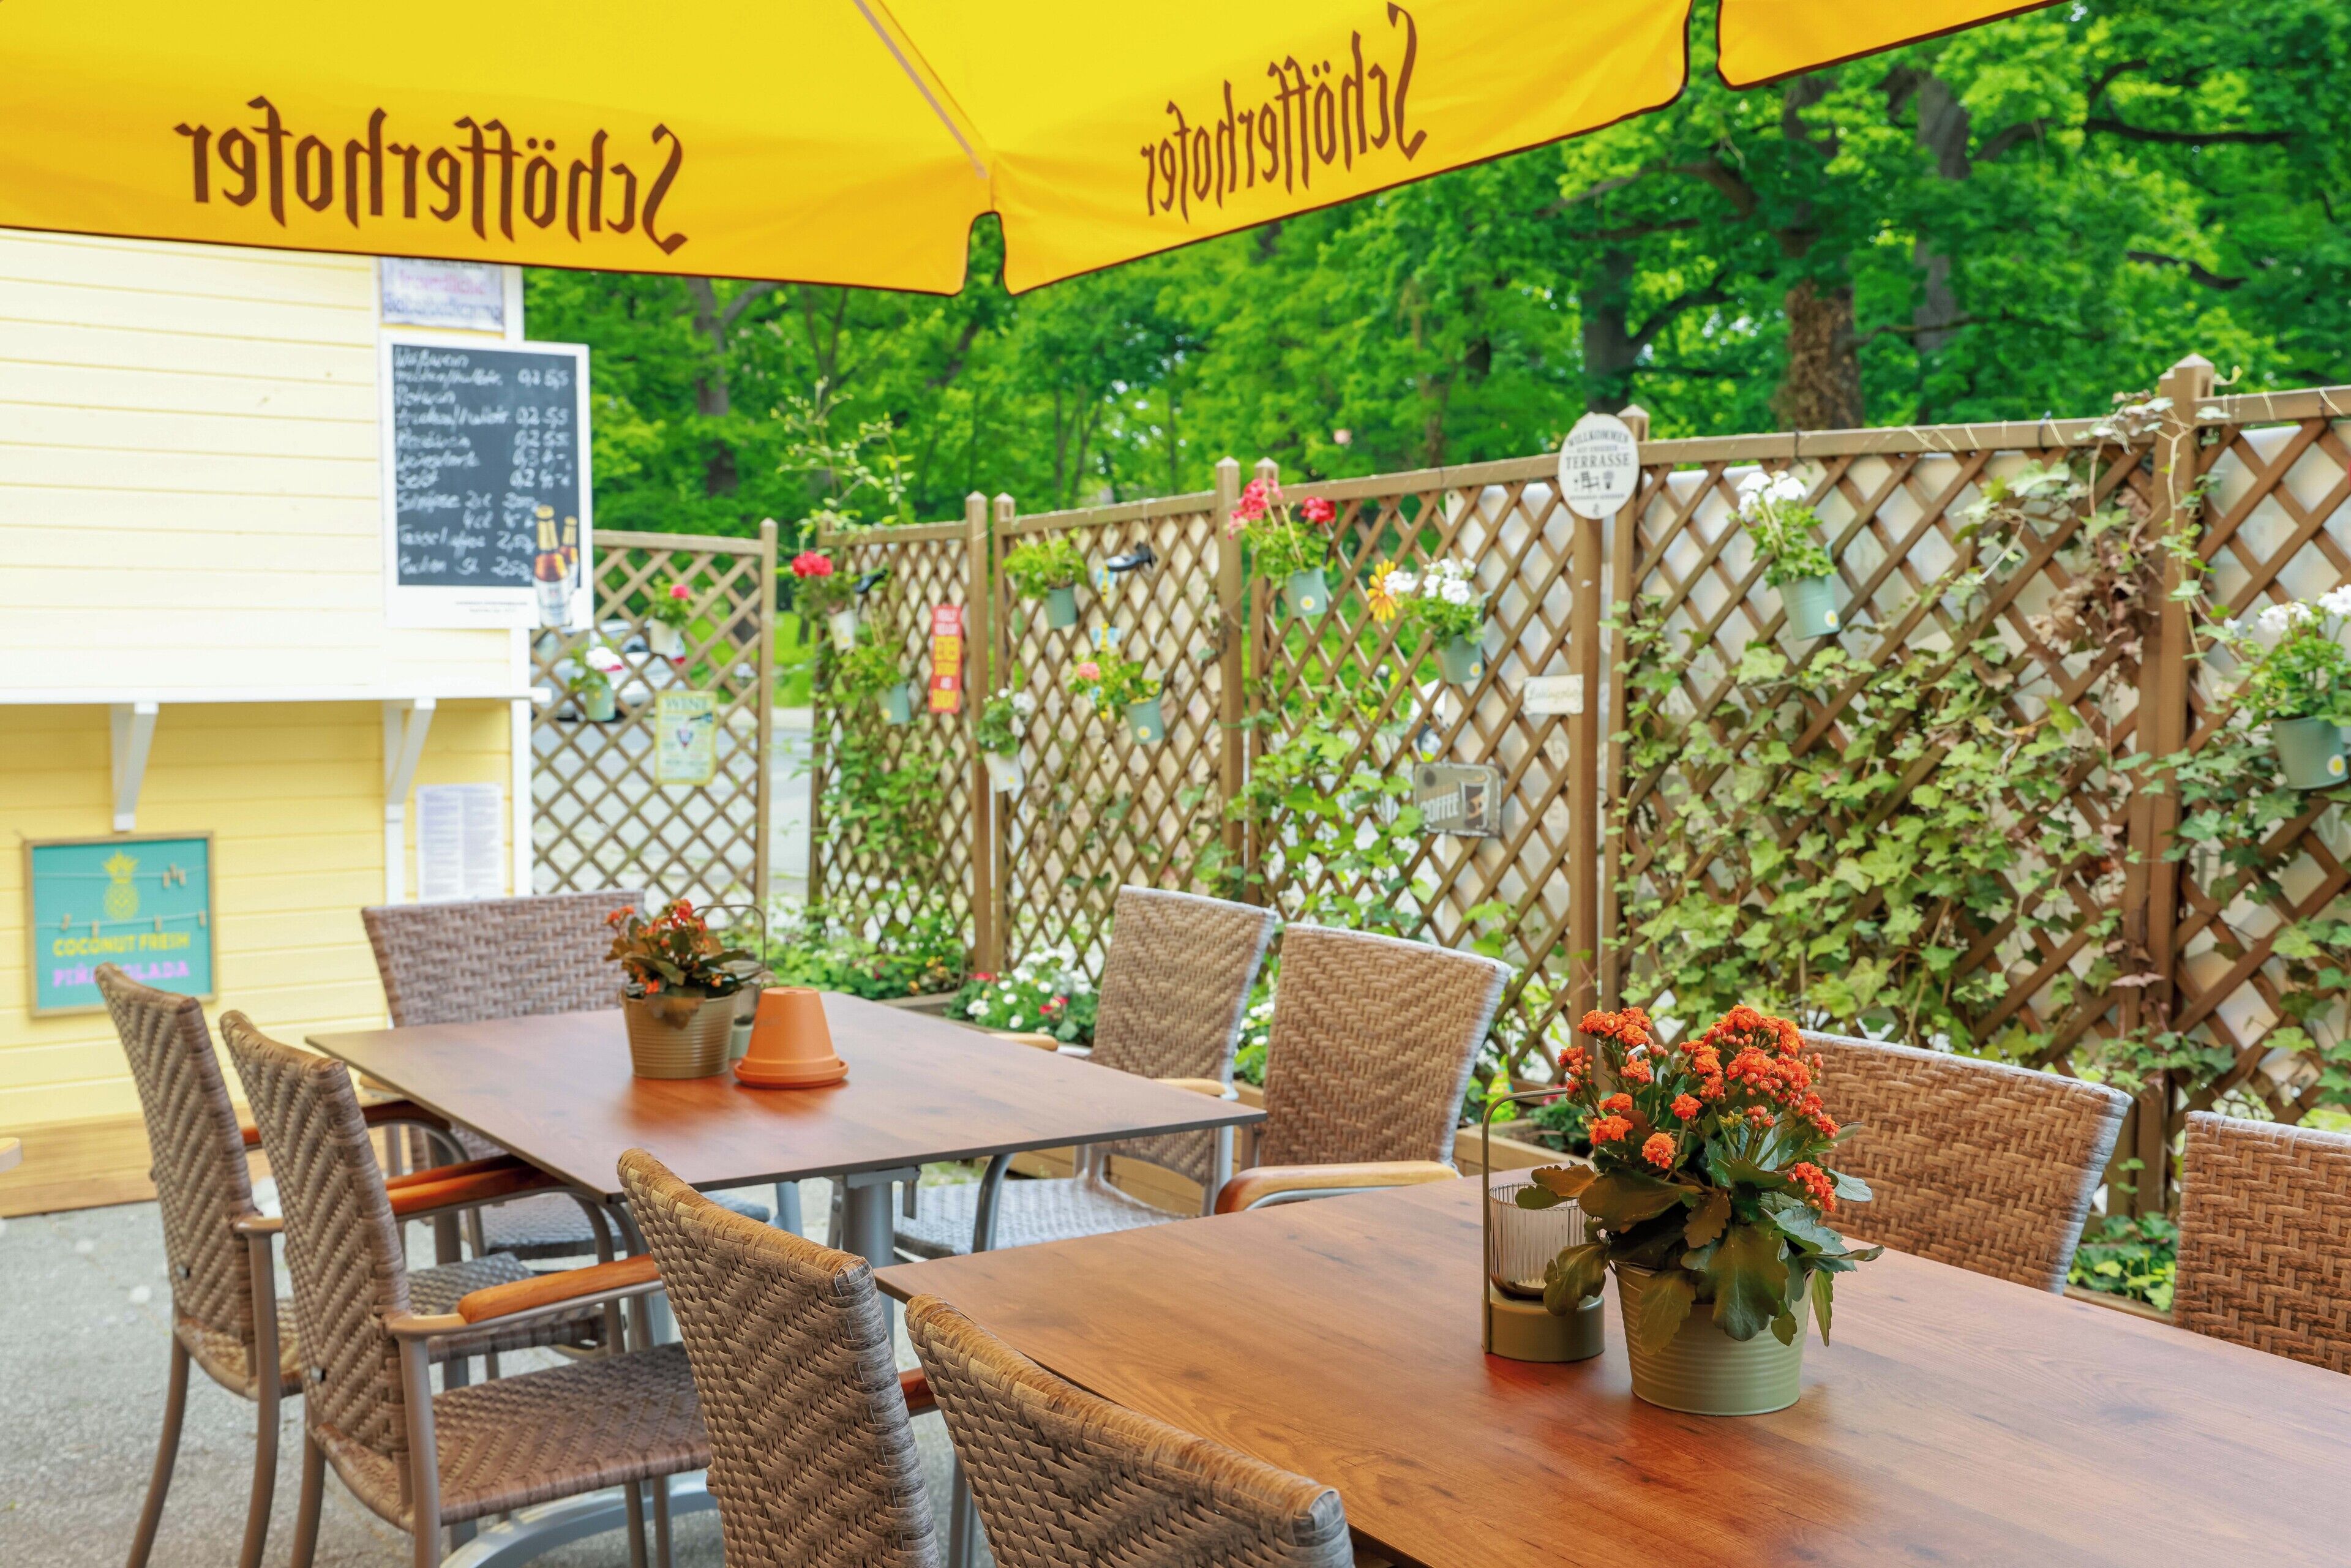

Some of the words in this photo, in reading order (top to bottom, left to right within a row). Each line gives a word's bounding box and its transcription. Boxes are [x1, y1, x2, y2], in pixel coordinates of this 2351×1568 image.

[1567, 430, 1629, 448] WILLKOMMEN
[1565, 453, 1630, 470] TERRASSE
[53, 934, 135, 958] COCONUT
